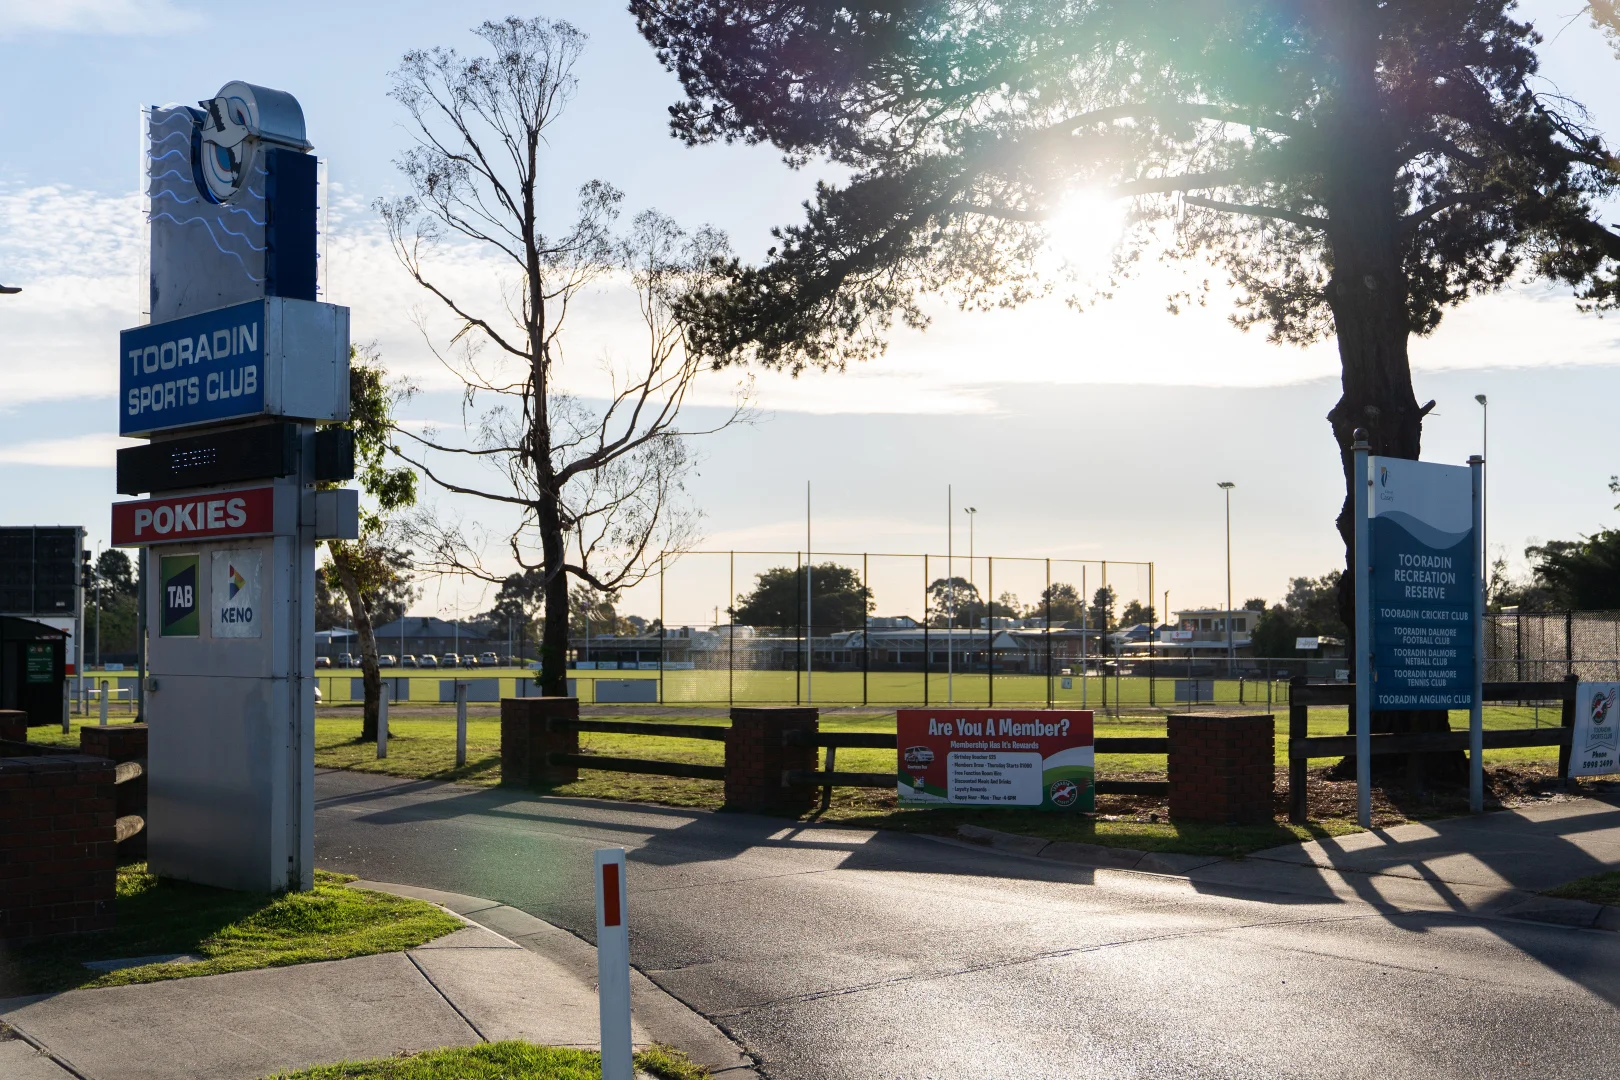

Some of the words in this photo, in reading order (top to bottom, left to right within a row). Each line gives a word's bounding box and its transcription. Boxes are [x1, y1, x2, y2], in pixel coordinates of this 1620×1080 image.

[129, 322, 258, 376] TOORADIN
[128, 376, 200, 416] SPORTS
[206, 365, 257, 402] CLUB
[134, 498, 247, 536] POKIES
[1398, 554, 1452, 569] TOORADIN
[1394, 569, 1456, 584] RECREATION
[167, 585, 193, 608] TAB
[1405, 585, 1445, 599] RESERVE
[221, 607, 253, 623] KENO
[1380, 608, 1419, 619] TOORADIN
[1421, 610, 1449, 620] CRICKET
[1451, 611, 1469, 621] CLUB
[1393, 627, 1427, 636] TOORADIN
[1428, 628, 1457, 637] DALMORE
[1402, 636, 1434, 644] FOOTBALL
[1434, 637, 1450, 645] CLUB
[1393, 648, 1427, 657] TOORADIN
[1428, 649, 1457, 657] DALMORE
[1405, 657, 1431, 666] NETBALL
[1432, 658, 1448, 666] CLUB
[1393, 669, 1427, 678] TOORADIN
[1428, 670, 1457, 678] DALMORE
[1407, 679, 1430, 687] TENNIS
[1430, 679, 1447, 687] CLUB
[1379, 695, 1417, 704] TOORADIN
[1419, 695, 1452, 704] ANGLING
[1453, 694, 1471, 704] CLUB
[928, 718, 953, 736] Are
[956, 718, 982, 736] You
[986, 718, 995, 736] A
[999, 718, 1070, 737] Member?
[950, 741, 988, 750] Membership
[989, 741, 1001, 749] Has
[1001, 741, 1011, 749] It's
[1012, 741, 1039, 749] Rewards
[1582, 760, 1598, 769] 5998
